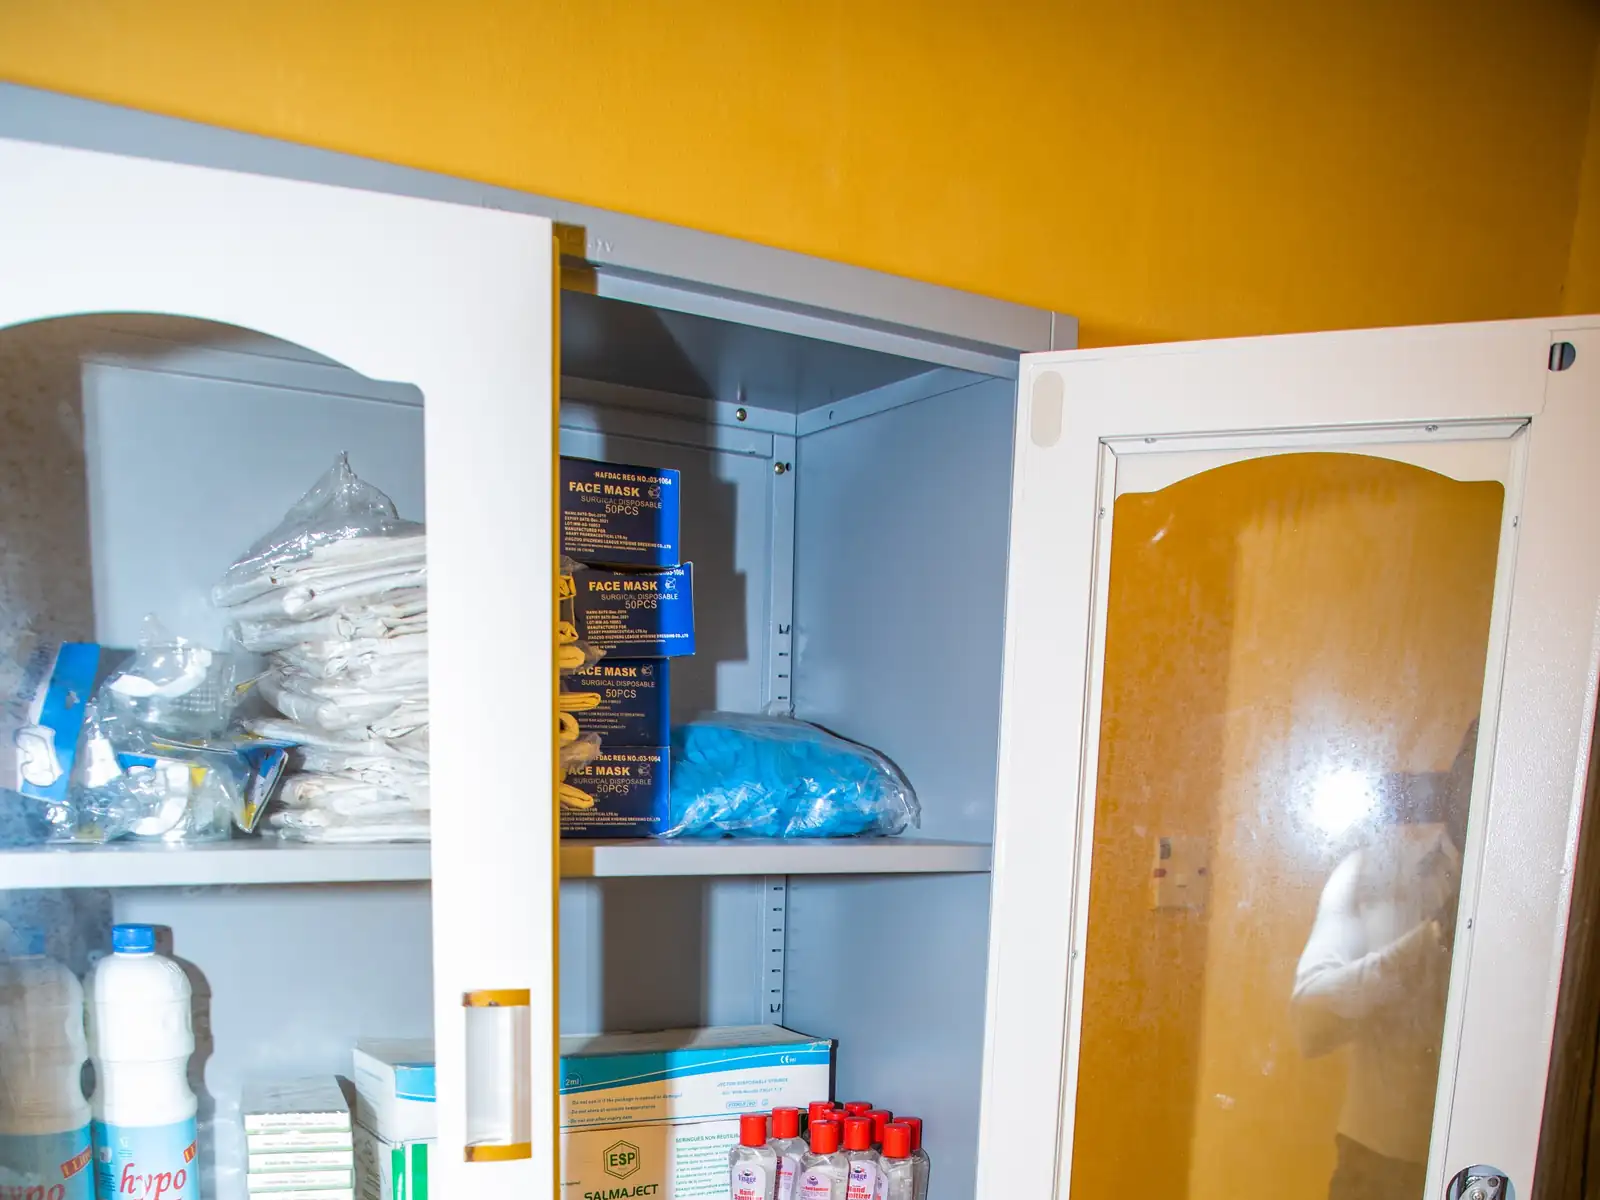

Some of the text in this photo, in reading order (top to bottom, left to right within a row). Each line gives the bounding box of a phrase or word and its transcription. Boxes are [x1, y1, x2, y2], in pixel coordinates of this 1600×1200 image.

[595, 471, 621, 480] NAFDAC
[569, 481, 640, 497] FACE MASK
[581, 495, 663, 509] SURGICAL DISPOSABLE
[605, 504, 639, 516] 50PCS
[588, 581, 658, 591] FACE MASK
[601, 593, 636, 601] SURGICAL
[625, 600, 657, 609] 50PCS
[572, 666, 637, 677] ACE MASK
[581, 679, 655, 688] SURGICAL DISPOSABLE
[605, 689, 637, 699] 50PCS
[567, 766, 630, 776] ACE MASK
[573, 777, 608, 785] SURGICAL
[596, 785, 629, 794] 50PCS
[565, 1078, 579, 1086] 2ml
[609, 1152, 636, 1166] ESP
[739, 1188, 755, 1196] Hand
